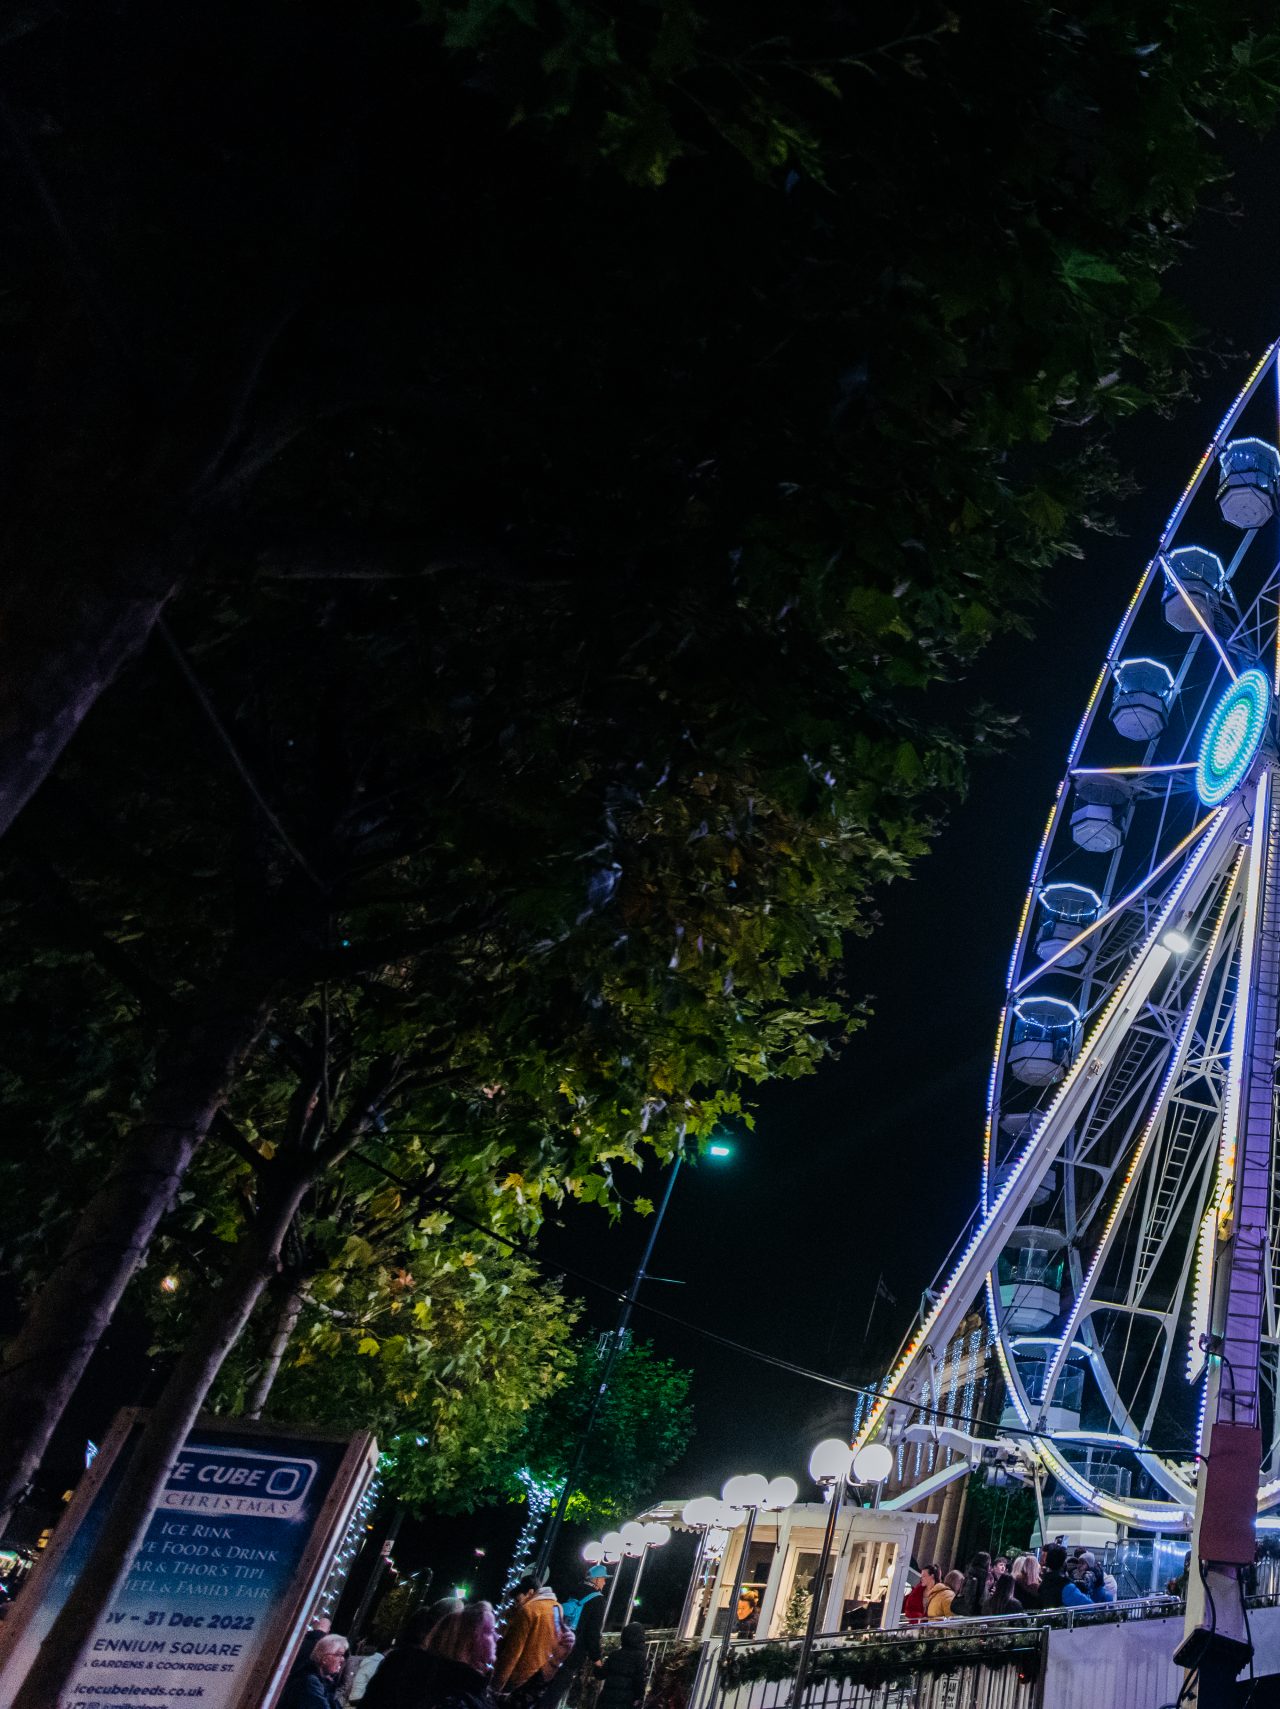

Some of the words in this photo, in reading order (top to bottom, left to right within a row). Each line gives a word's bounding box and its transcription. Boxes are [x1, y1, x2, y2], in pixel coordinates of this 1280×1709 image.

[197, 1465, 265, 1486] CUBE
[165, 1493, 289, 1515] CHRISTMAS
[161, 1522, 187, 1535] ICE
[192, 1523, 235, 1539] RINK
[162, 1541, 209, 1556] FOOD
[211, 1546, 222, 1558] &
[226, 1545, 278, 1562] DRINK
[236, 1584, 271, 1599] FAIR
[143, 1611, 165, 1626] 31
[168, 1612, 204, 1628] Dec
[207, 1614, 255, 1630] 2022
[169, 1641, 243, 1657] SQUARE
[91, 1659, 144, 1669] GARDENS
[146, 1661, 154, 1669] &
[156, 1661, 219, 1672] COOKRIDGE
